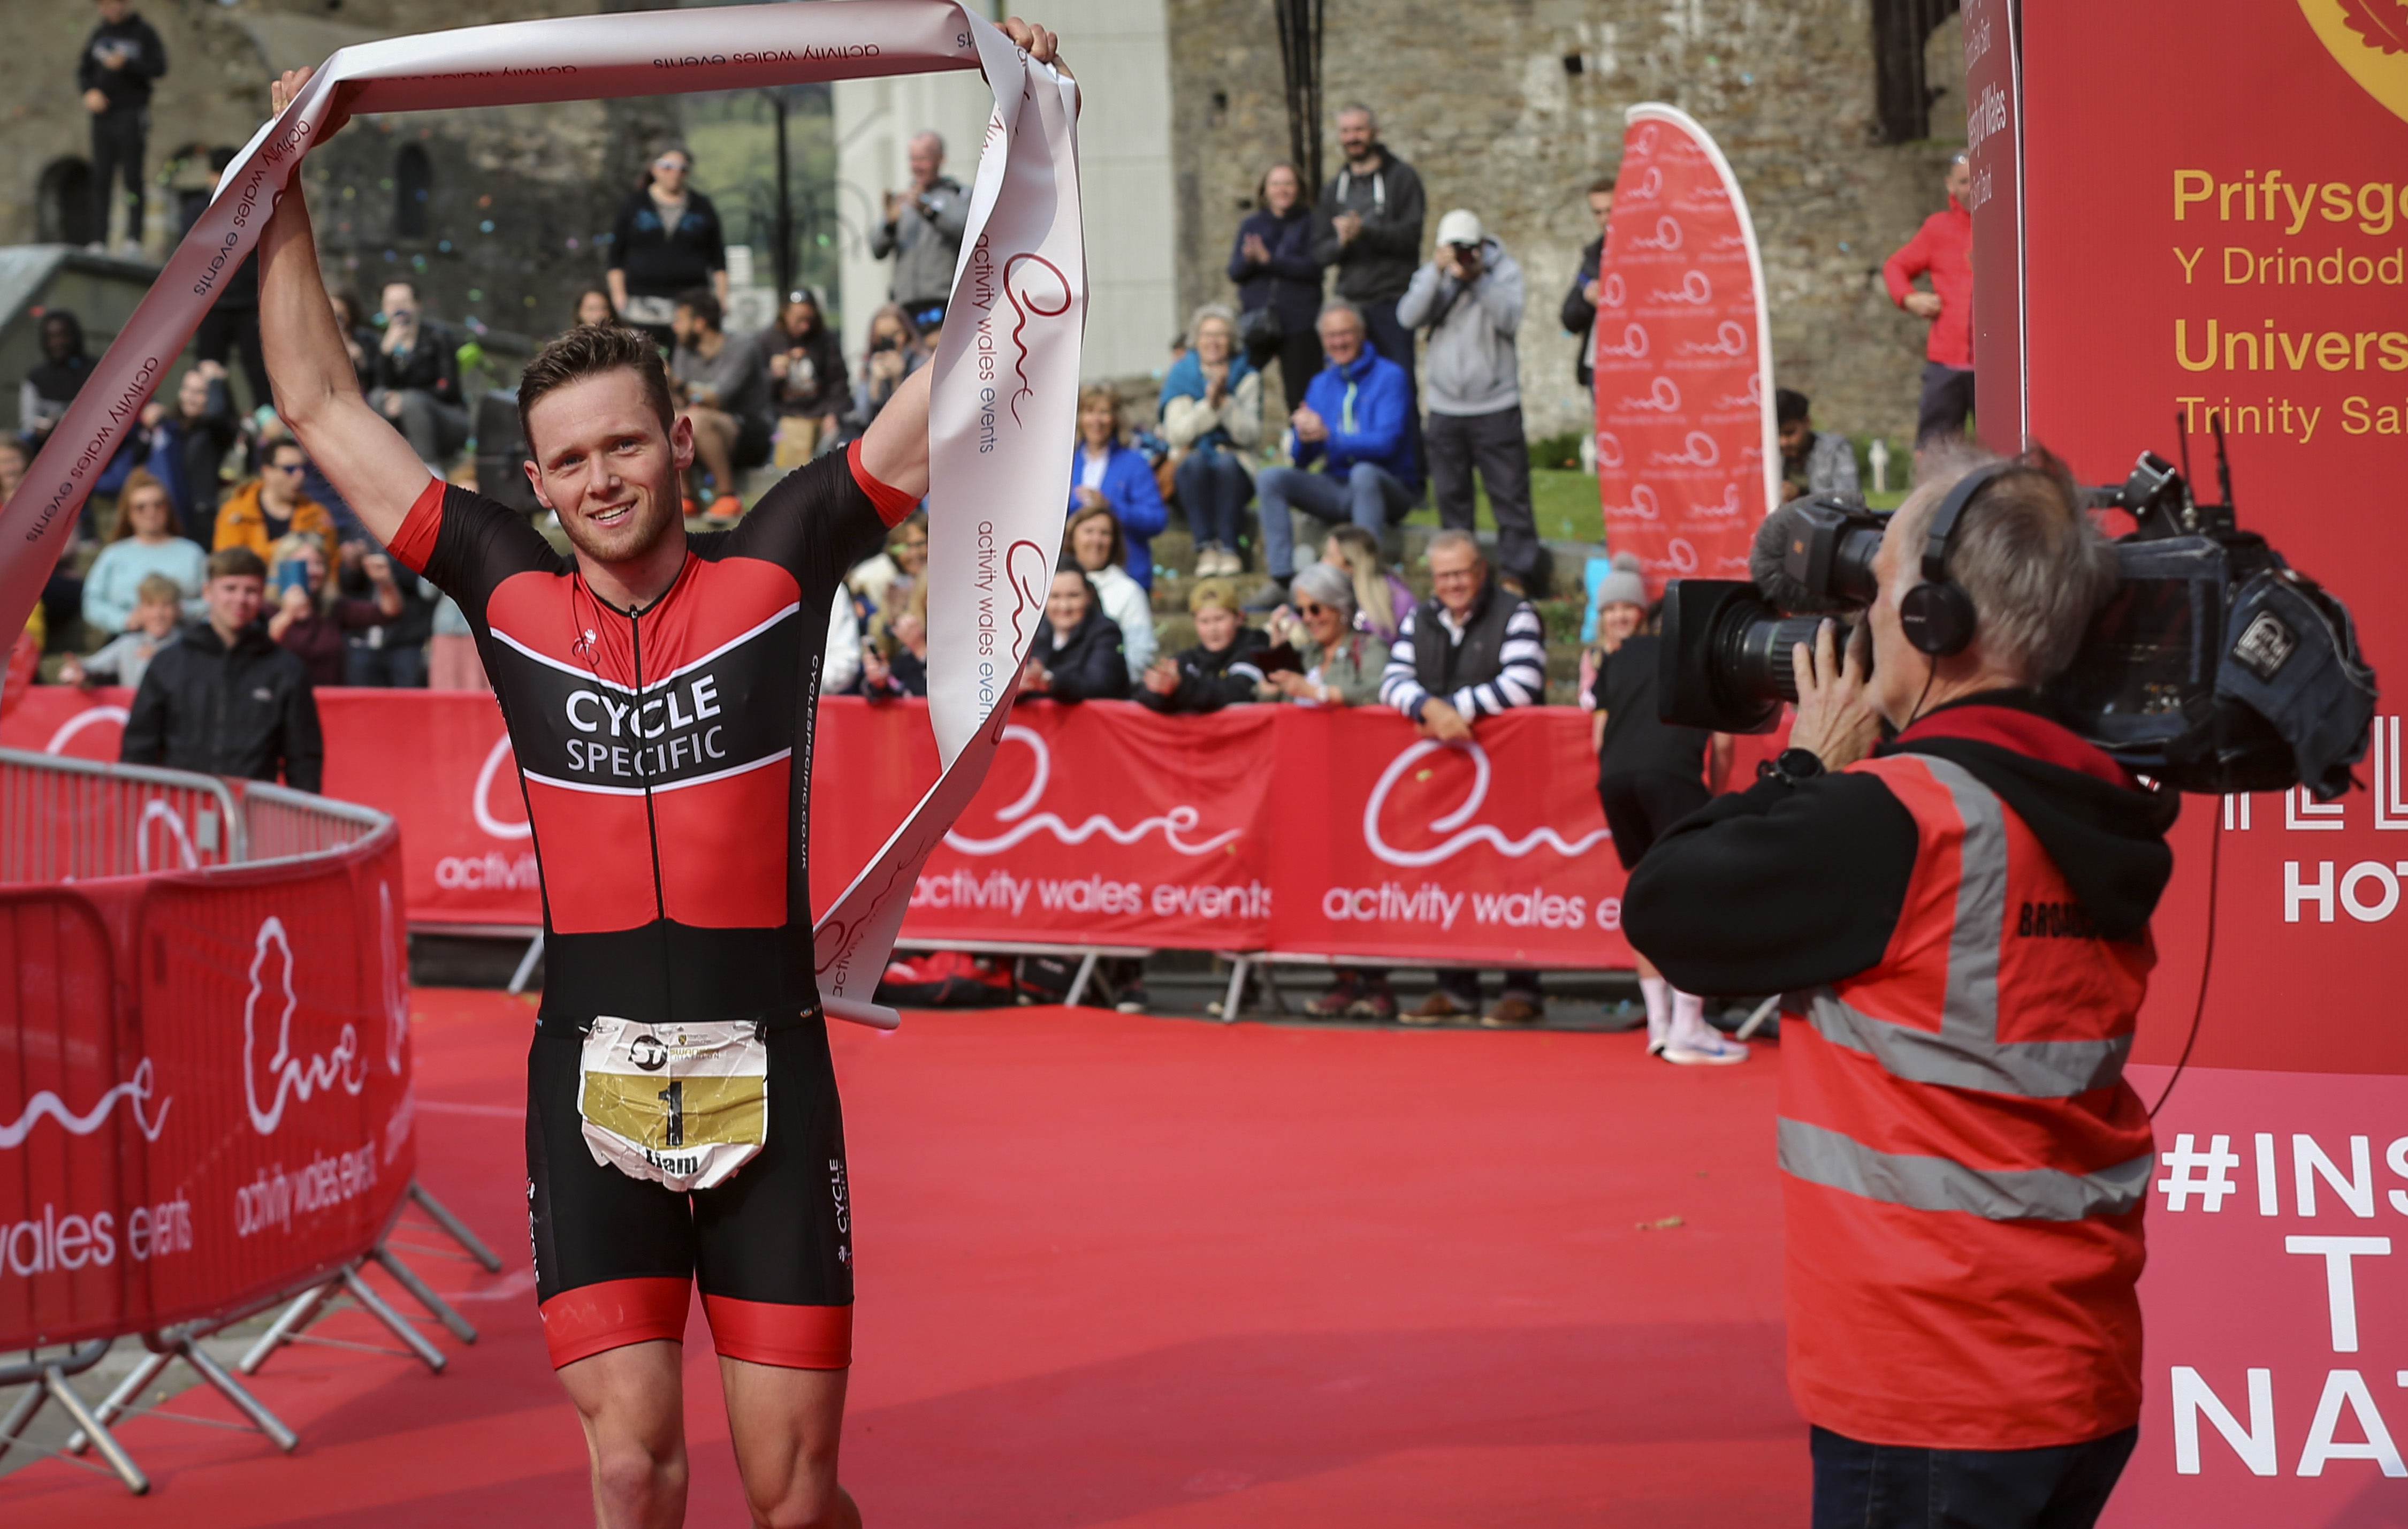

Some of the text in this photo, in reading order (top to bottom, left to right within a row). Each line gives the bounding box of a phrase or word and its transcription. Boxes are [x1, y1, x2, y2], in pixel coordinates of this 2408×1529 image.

[653, 44, 880, 69] activity wales events
[1984, 81, 2007, 137] Wales
[193, 120, 311, 296] activity wales events
[2173, 247, 2404, 285] Y Drindod
[972, 233, 998, 454] activity wales events
[2175, 318, 2408, 372] Univers
[26, 356, 158, 543] activity wales events
[2176, 397, 2322, 444] Trinity
[974, 520, 997, 592] activity
[978, 596, 997, 657] wales
[565, 674, 721, 738] CYCLE
[566, 725, 726, 777] SPECIFIC
[802, 654, 819, 870] CYCLESPECIFIC.CO.UK
[909, 868, 1272, 919] activity wales events
[1322, 881, 1465, 932] activity
[1472, 887, 1586, 930] wales
[658, 1081, 683, 1146] 1
[294, 1149, 341, 1213] wales
[829, 1158, 847, 1234] CYCLE
[2284, 1235, 2392, 1353] T
[2170, 1365, 2408, 1478] NA
